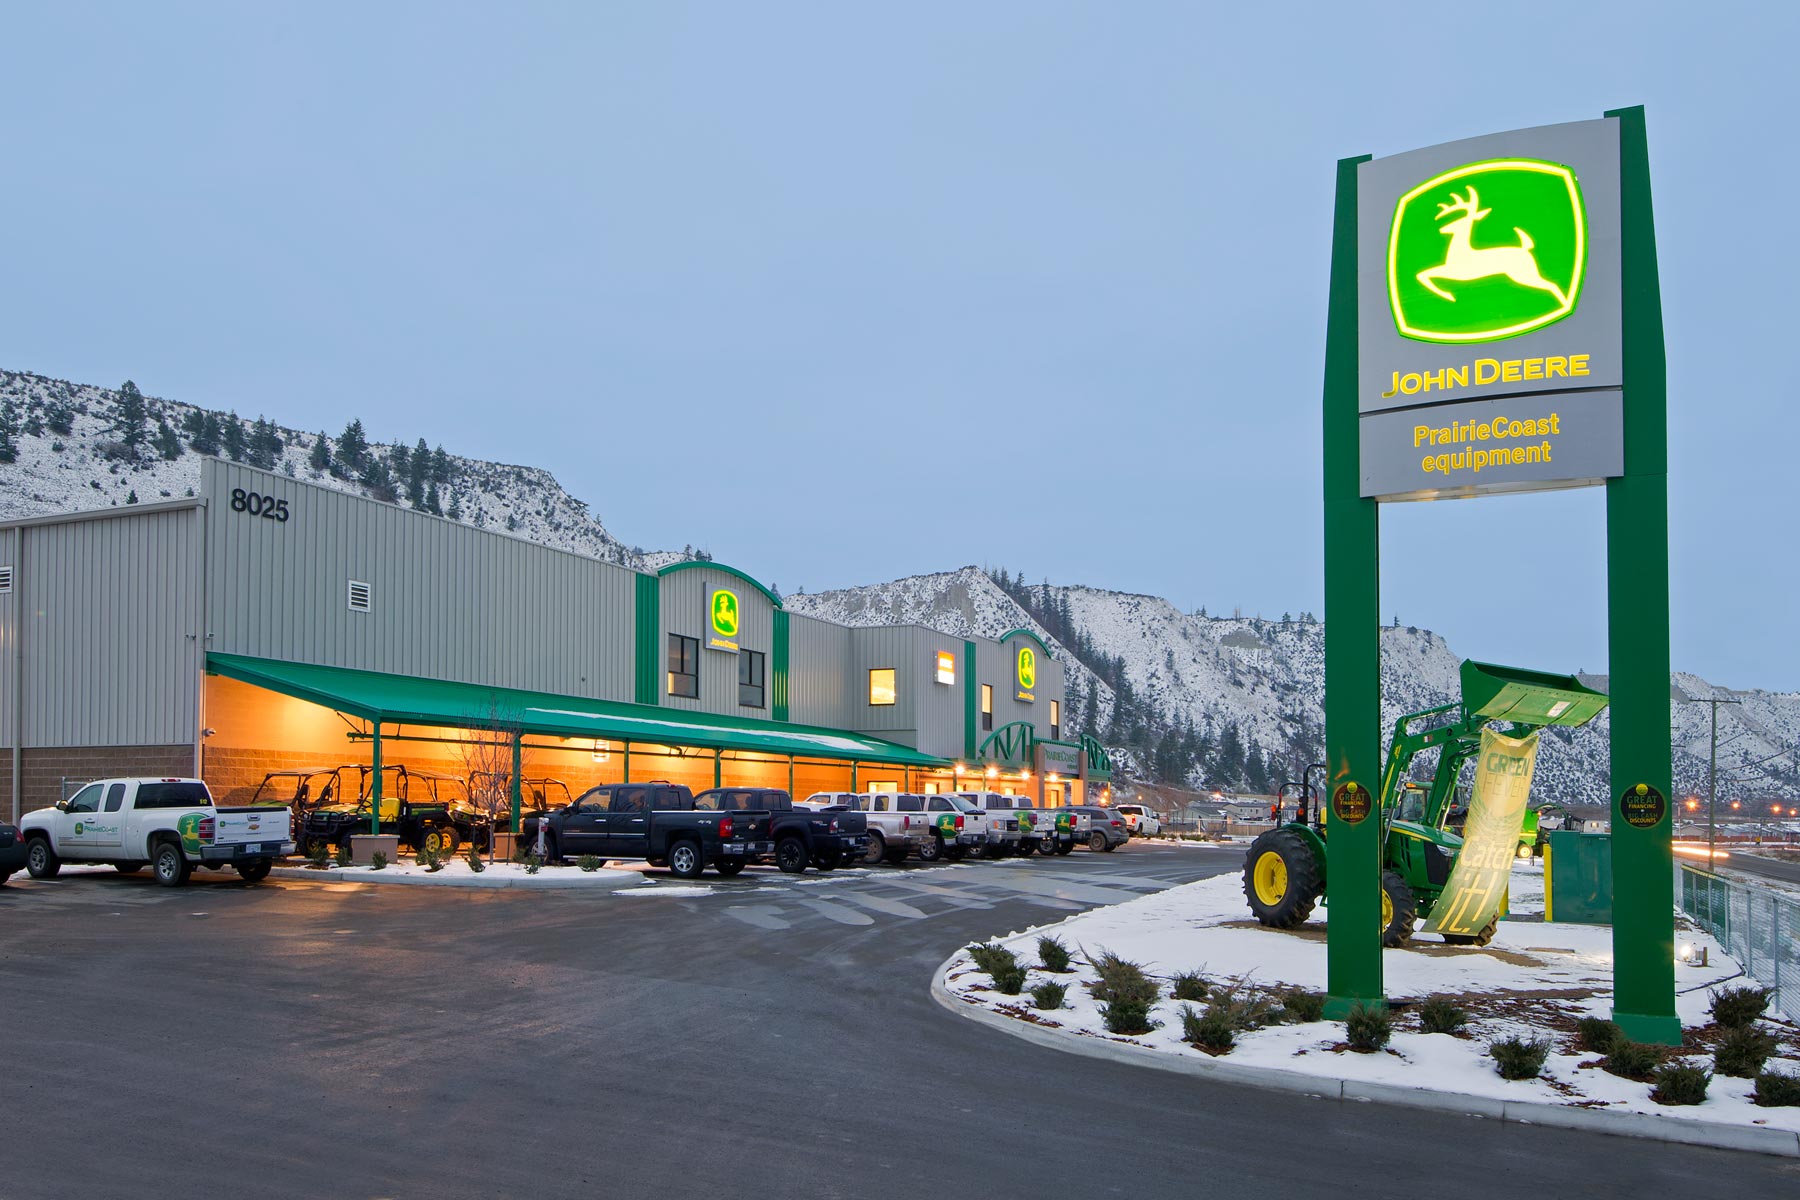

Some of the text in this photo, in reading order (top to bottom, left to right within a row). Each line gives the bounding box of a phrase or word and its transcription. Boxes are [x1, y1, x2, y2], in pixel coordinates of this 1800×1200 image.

[1382, 354, 1590, 398] JOHN DEERE
[1414, 413, 1560, 447] PrairieCoast
[1422, 441, 1552, 475] equipment
[231, 488, 290, 522] 8025
[1486, 752, 1530, 776] GREEN
[1339, 793, 1366, 801] GREAT
[1483, 772, 1527, 798] FEVER
[1626, 795, 1657, 804] GREAT
[1460, 836, 1516, 870] Catch
